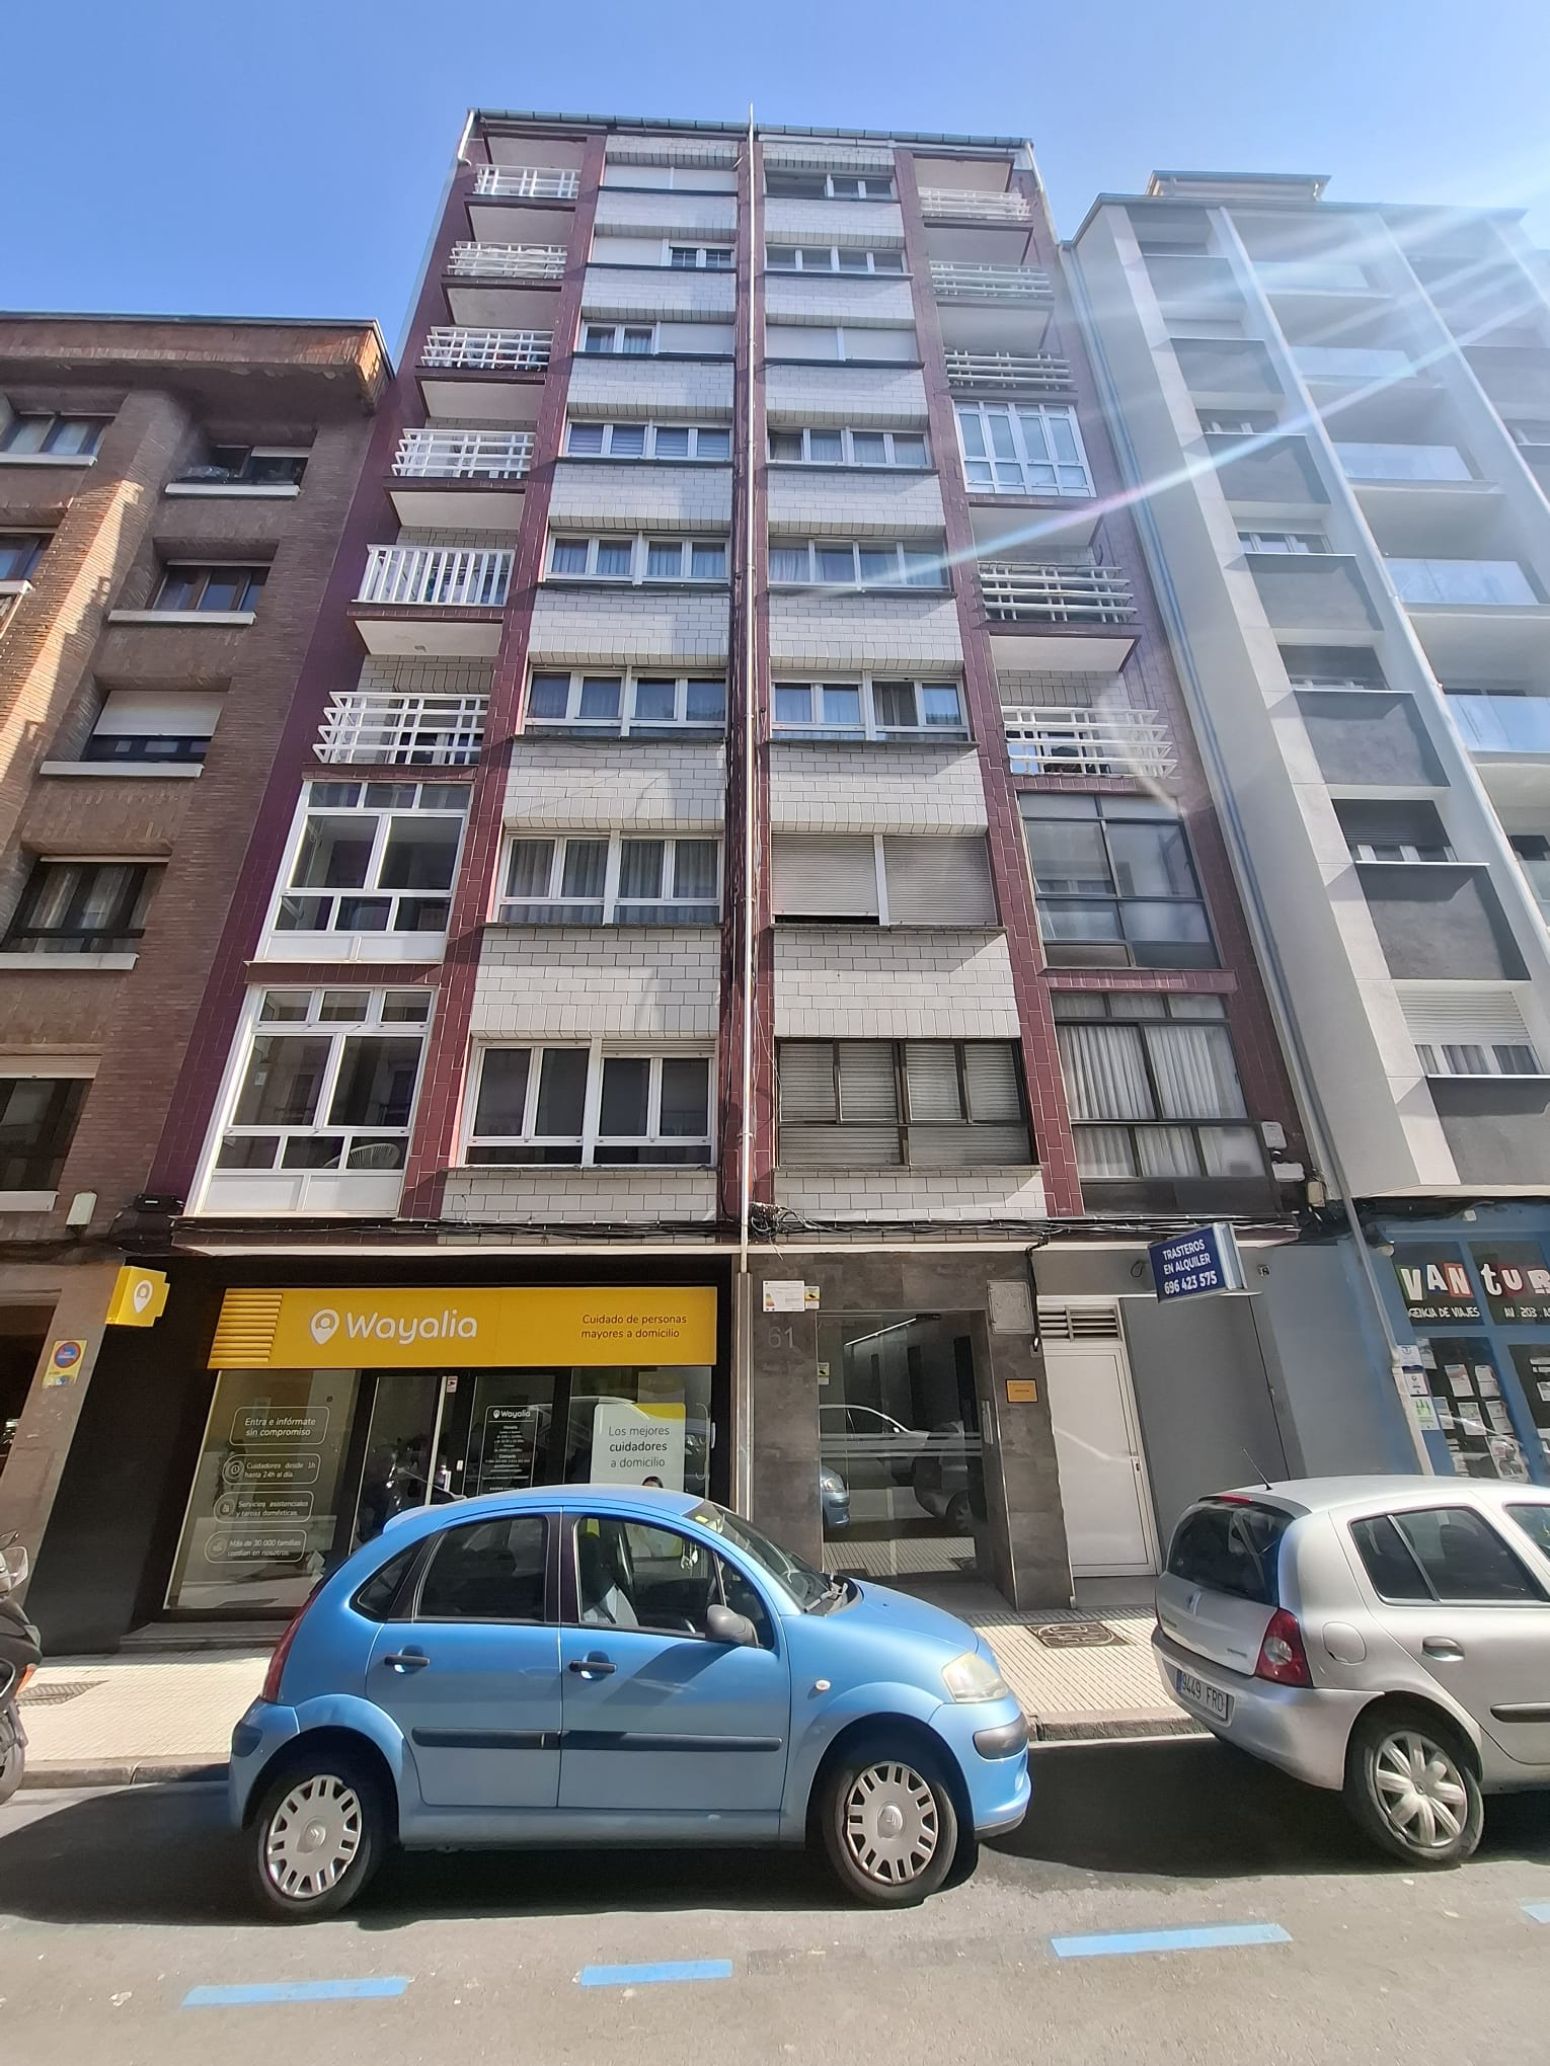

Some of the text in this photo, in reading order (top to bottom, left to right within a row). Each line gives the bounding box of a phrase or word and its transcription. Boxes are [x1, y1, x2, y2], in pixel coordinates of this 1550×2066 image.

[1162, 1239, 1206, 1261] TRASTEROS
[1163, 1252, 1212, 1275] EN ALQUILER
[1164, 1270, 1218, 1295] 696 423 575
[1400, 1264, 1471, 1301] VAN
[1439, 1307, 1450, 1318] DE
[1451, 1306, 1480, 1318] VIAJES
[346, 1308, 479, 1345] Wayalia
[582, 1314, 687, 1327] Cuidado de personas
[581, 1327, 680, 1340] mayores a domicilio
[768, 1326, 794, 1348] 61
[501, 1409, 531, 1419] Wayalia
[244, 1417, 267, 1426] Entra
[276, 1417, 316, 1426] infórmate
[246, 1428, 311, 1438] sin compromiso
[608, 1425, 671, 1438] Los mejores
[609, 1441, 668, 1453] cuidadores
[610, 1457, 666, 1468] a domicilio
